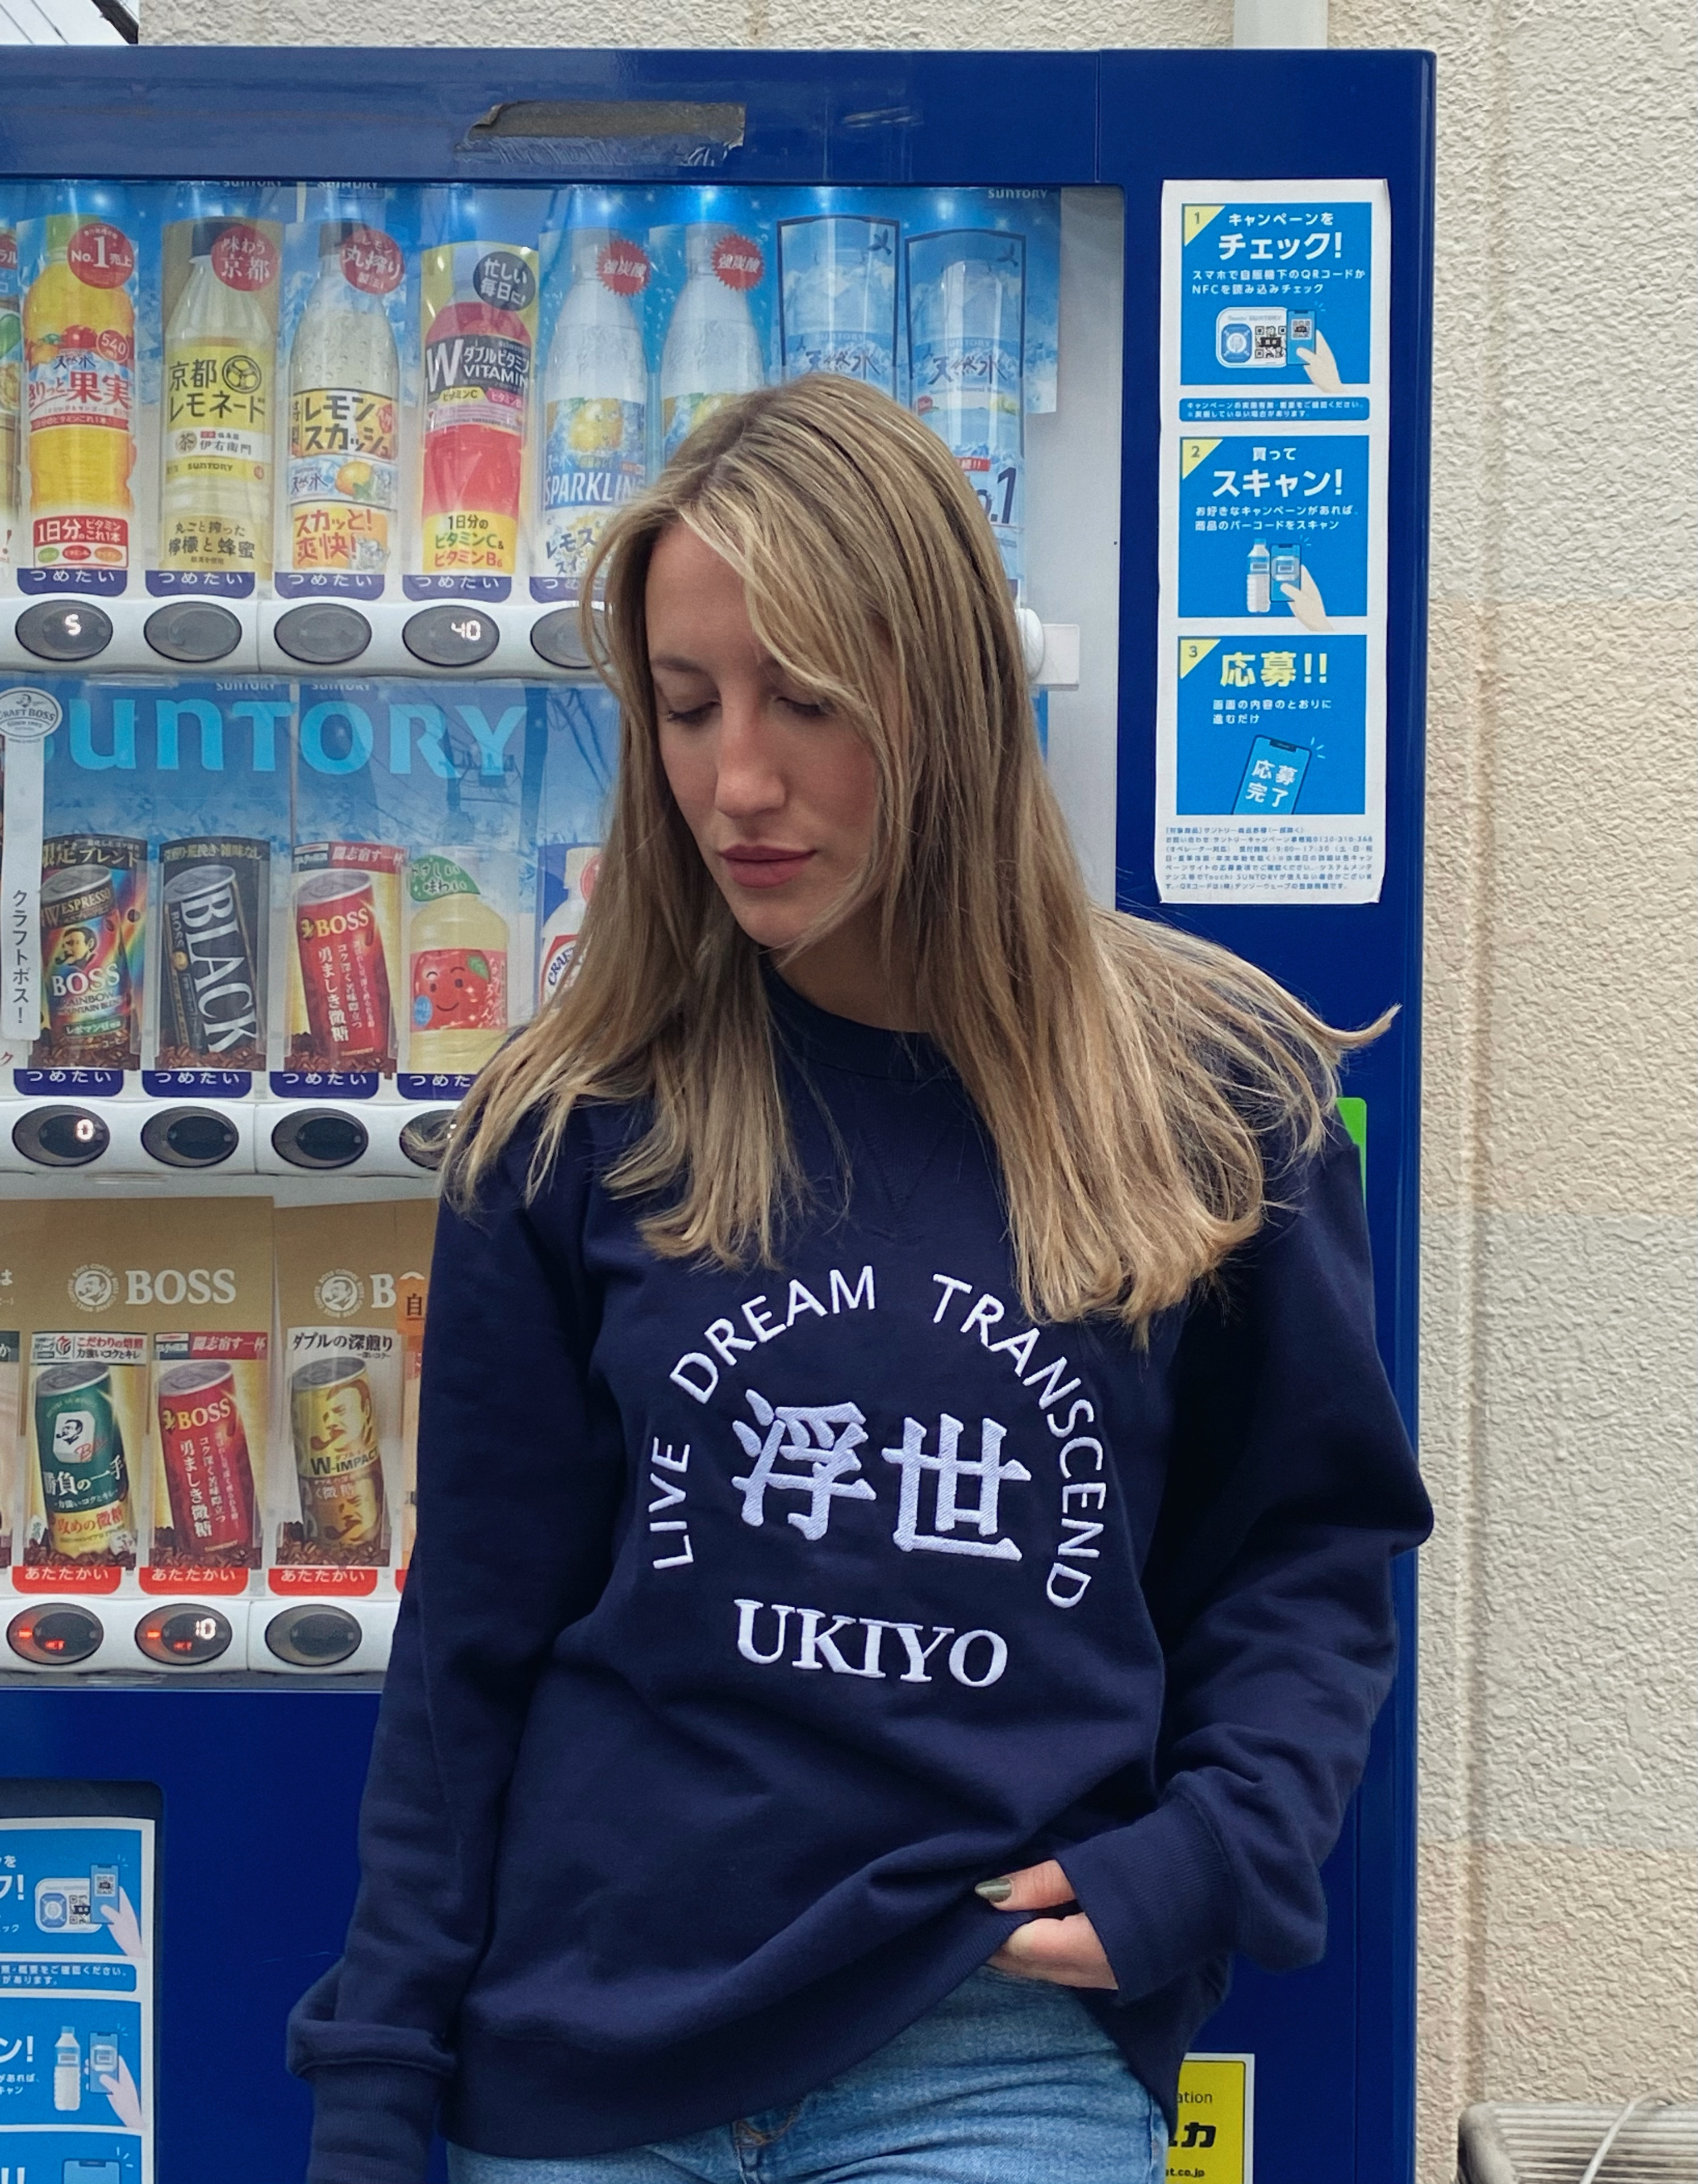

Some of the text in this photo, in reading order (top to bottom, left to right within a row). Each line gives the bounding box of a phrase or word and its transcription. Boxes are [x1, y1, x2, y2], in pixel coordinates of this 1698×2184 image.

[988, 189, 1048, 199] SUNTORY
[1194, 212, 1200, 224] 1
[1228, 212, 1334, 227] キャンペーンを
[220, 237, 266, 253] 味わう
[1219, 231, 1342, 260] チェック!
[221, 253, 270, 283] 京都
[484, 257, 527, 284] 忙しい
[101, 333, 126, 355] 540
[169, 359, 218, 391] 京都
[463, 364, 529, 387] VITAMIN
[927, 354, 1008, 385] 天然水
[170, 390, 265, 423] レモネード
[305, 395, 376, 422] レモン
[304, 423, 389, 457] スカッシュ
[1190, 445, 1200, 458] 2
[1252, 447, 1296, 461] 買って
[1212, 468, 1342, 498] スキャン!
[86, 519, 121, 531] ビタミン
[294, 509, 373, 538] スカッと!
[447, 514, 489, 530] 1日分の
[296, 535, 358, 565] 爽快!
[30, 570, 115, 583] つめたい
[158, 572, 243, 585] つめたい
[287, 573, 372, 586] つめたい
[415, 575, 500, 589] つめたい
[1188, 645, 1198, 657] 3
[1220, 651, 1328, 687] 応募!!
[44, 698, 528, 779] UNTORY
[1251, 759, 1298, 786] 応募
[1245, 782, 1289, 808] 完了
[315, 907, 369, 937] BOSS
[12, 890, 30, 1024] クラフトボス!
[181, 884, 257, 1053] BLACK
[548, 945, 576, 986] CRAF
[51, 962, 120, 997] BOSS
[26, 1070, 111, 1083] つめたい
[155, 1070, 240, 1085] つめたい
[282, 1072, 368, 1086] つめたい
[409, 1074, 472, 1087] つめた
[124, 1268, 236, 1305] BOSS
[293, 1332, 393, 1352] ダブルの深煎り
[669, 1265, 876, 1404] DREAM
[176, 1398, 231, 1431] BOSS
[932, 1273, 1107, 1608] TRANSCEND
[731, 1387, 1032, 1562] 浮世
[648, 1436, 694, 1569] LIVE
[24, 1567, 109, 1580] あたたかい
[152, 1568, 236, 1581] あたたかい
[281, 1569, 365, 1583] あたたかい
[733, 1598, 1008, 1687] UKIYO
[1169, 2122, 1216, 2148] カ
